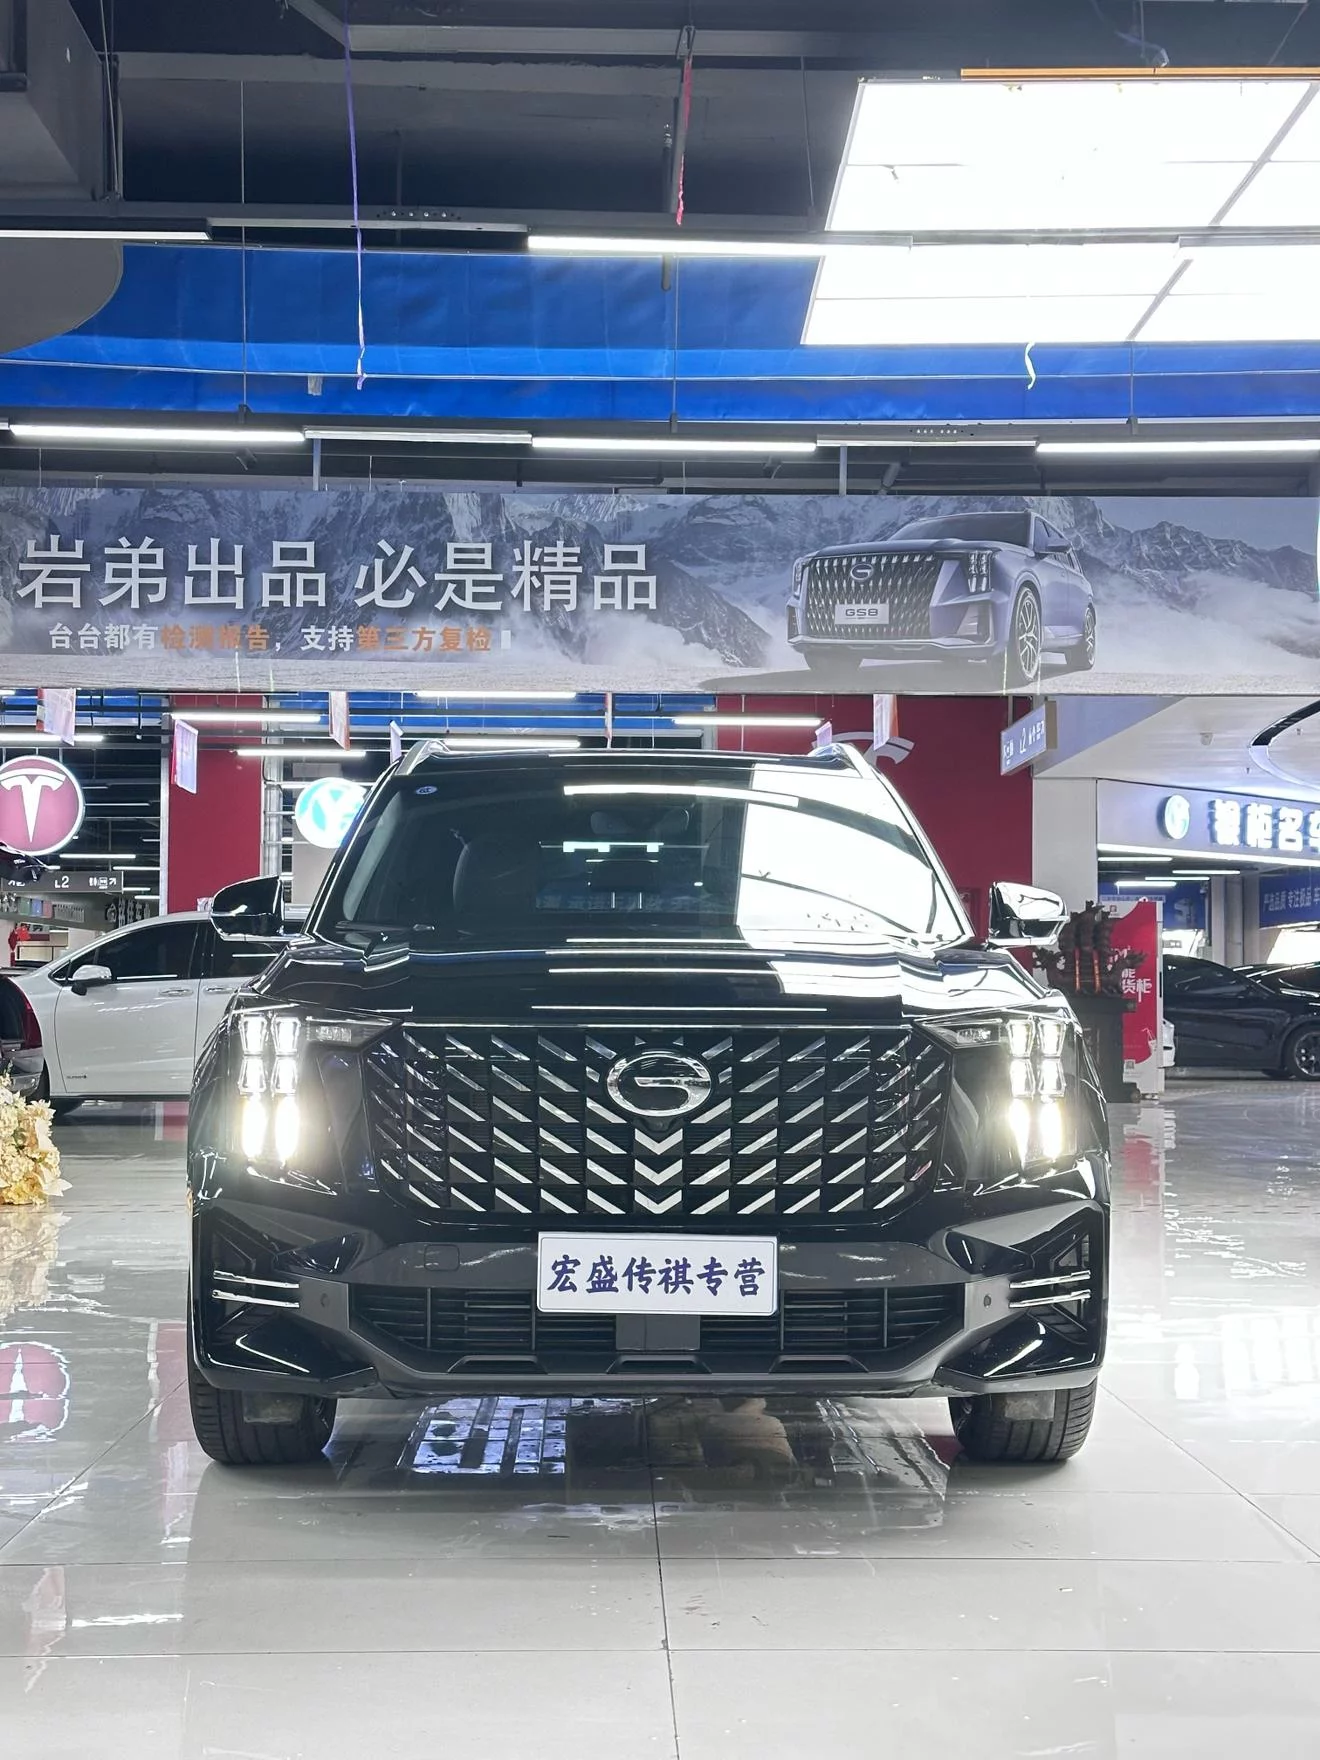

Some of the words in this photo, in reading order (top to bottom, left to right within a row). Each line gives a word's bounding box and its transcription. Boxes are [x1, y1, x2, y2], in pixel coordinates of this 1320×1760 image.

[17, 534, 326, 609] 岩弟出品
[354, 539, 657, 612] 必是精品
[845, 608, 879, 617] GS8
[54, 875, 70, 889] L2
[547, 1254, 765, 1297] 宏盛传祺专营
